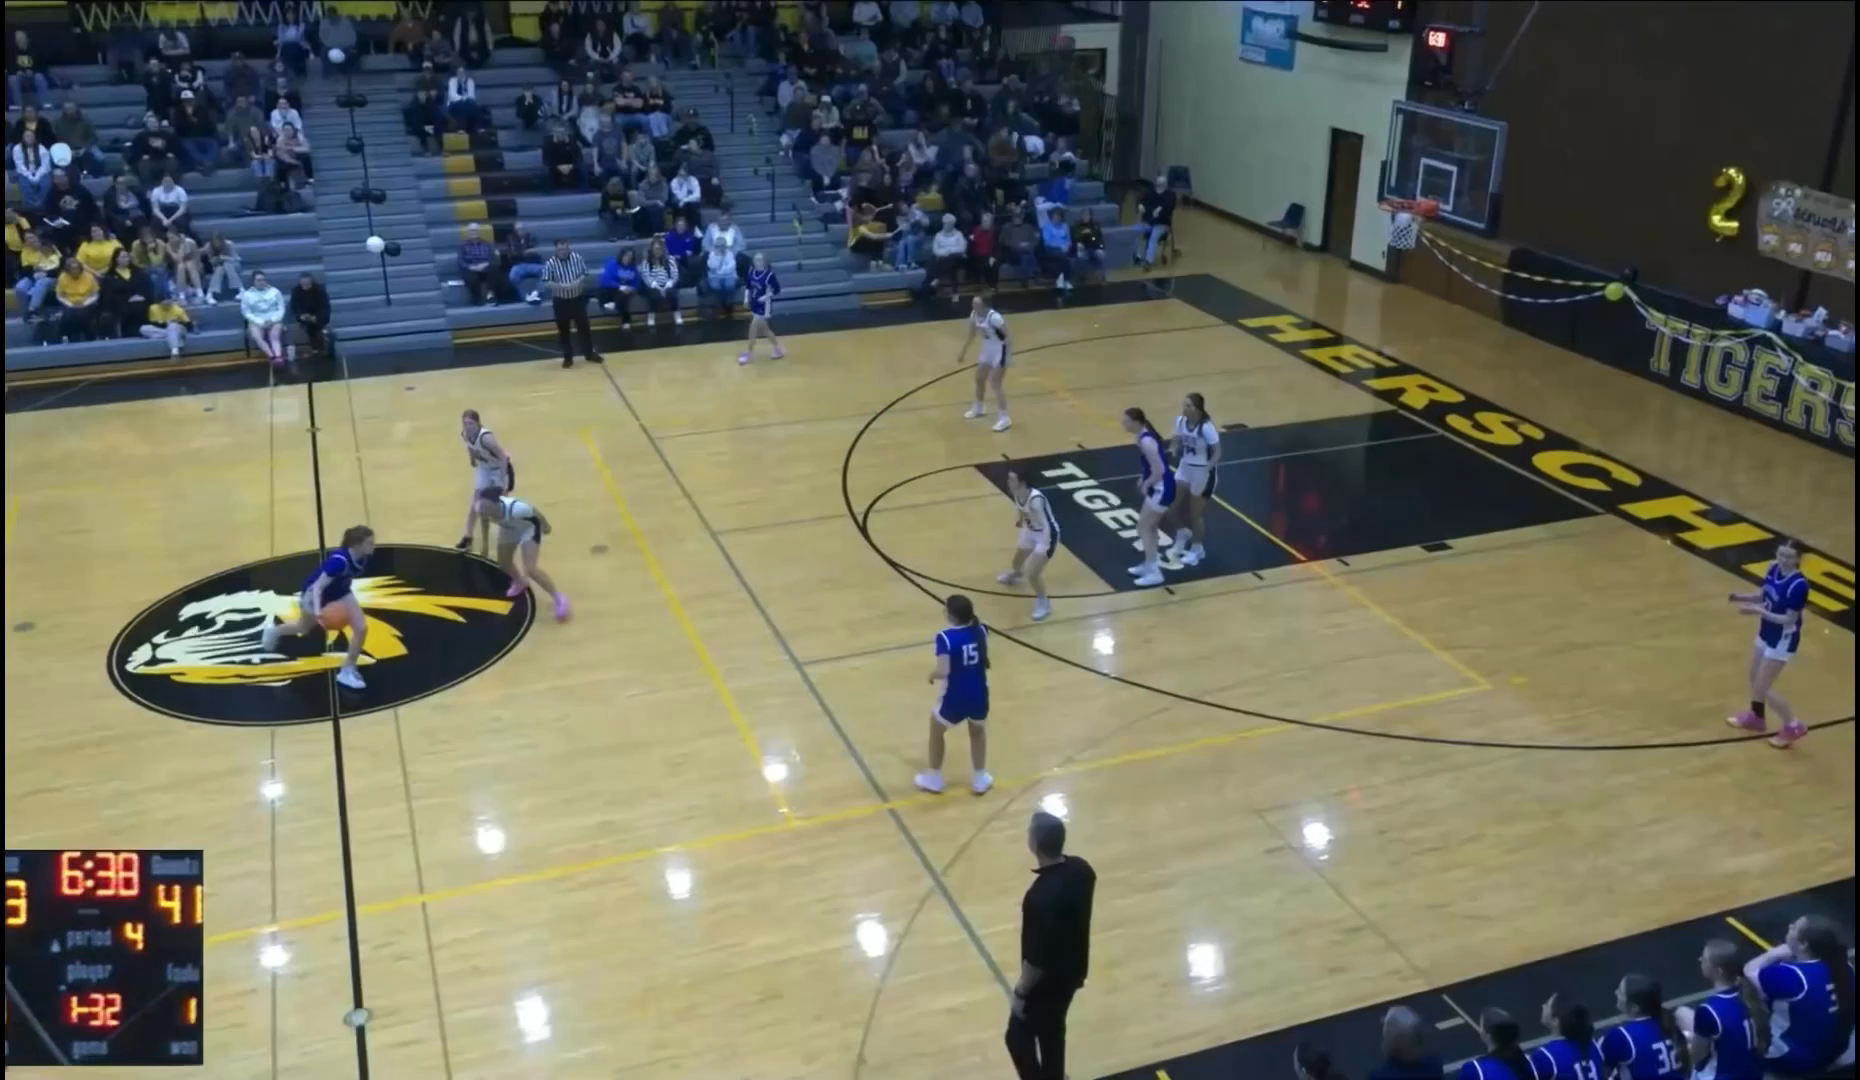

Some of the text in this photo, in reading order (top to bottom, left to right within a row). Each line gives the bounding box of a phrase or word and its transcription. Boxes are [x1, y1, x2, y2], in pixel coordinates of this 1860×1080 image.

[1710, 167, 1746, 236] 2
[962, 642, 980, 666] 15
[62, 851, 139, 895] 6:38
[157, 884, 203, 923] 41
[124, 922, 144, 949] 4
[1652, 1039, 1682, 1075] 32
